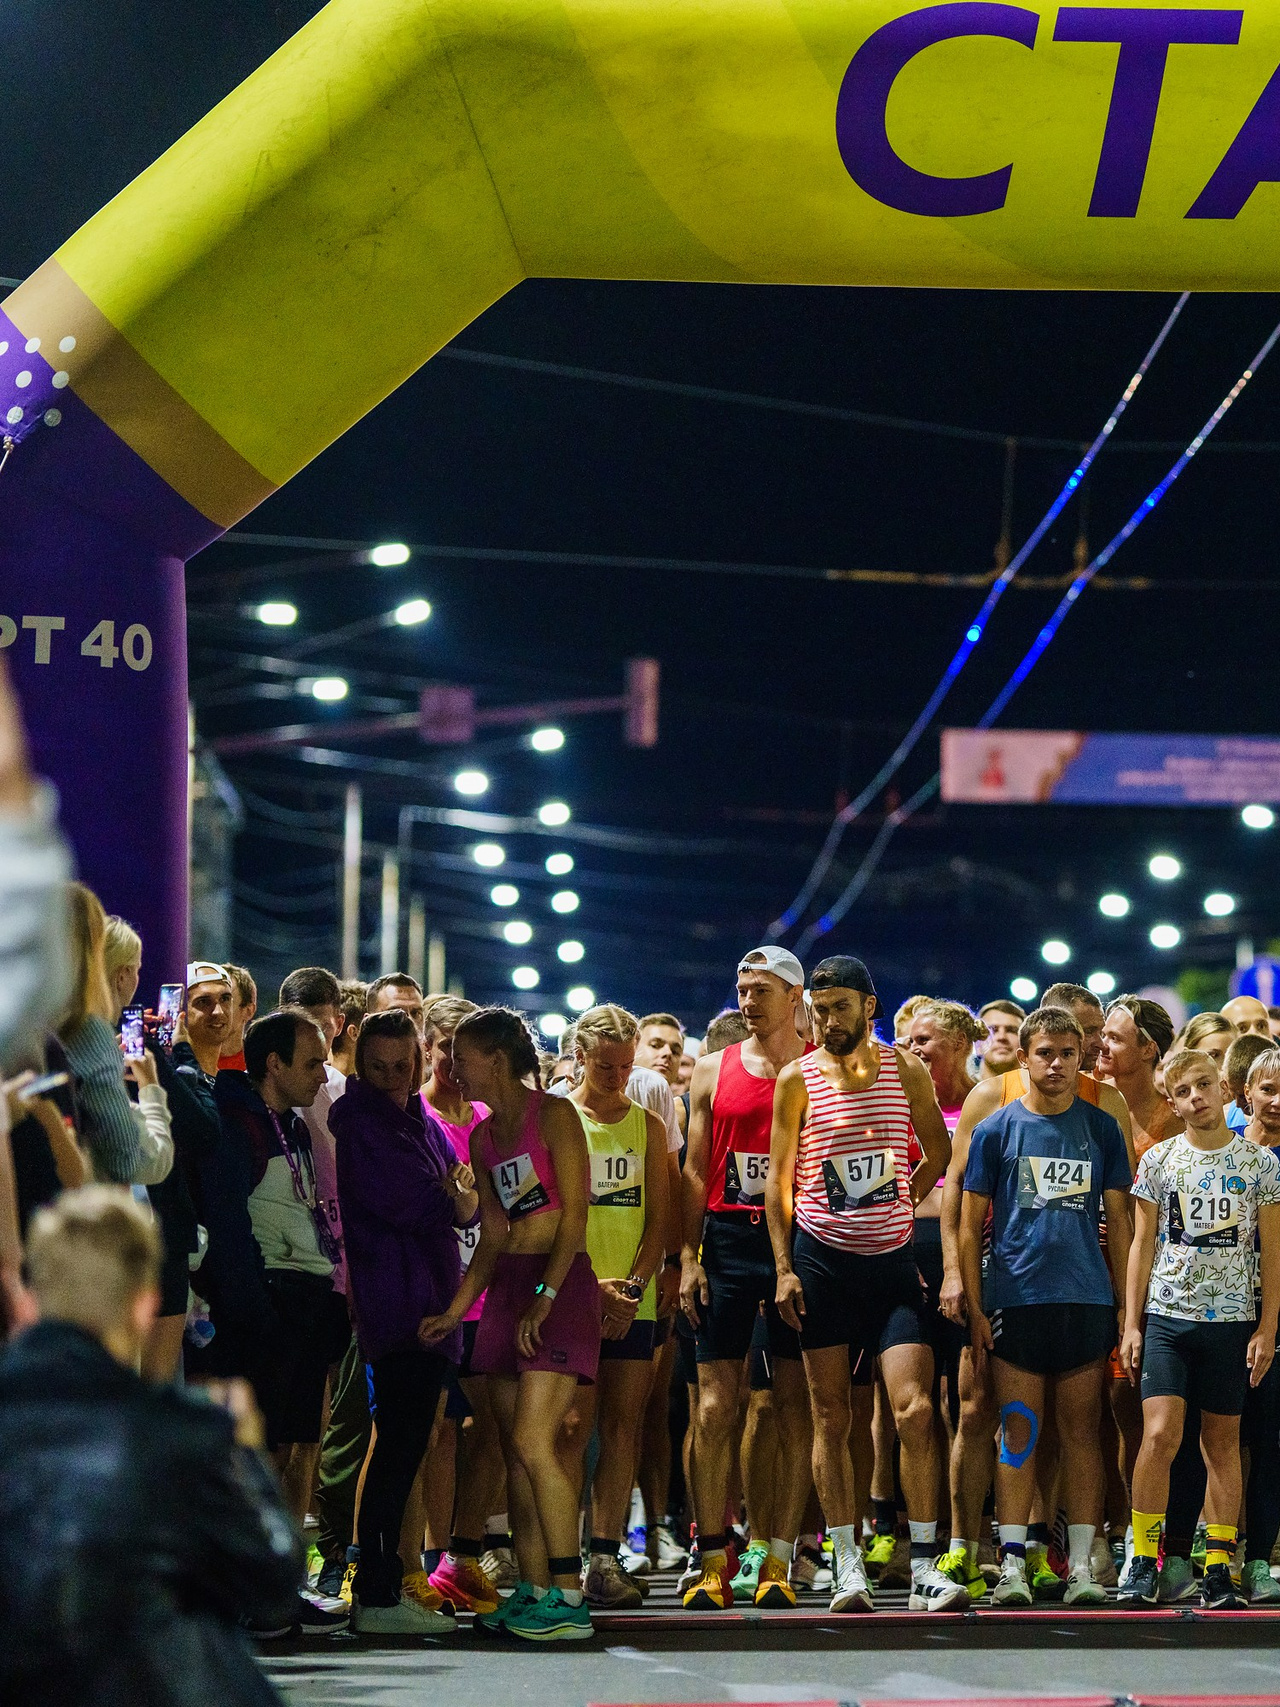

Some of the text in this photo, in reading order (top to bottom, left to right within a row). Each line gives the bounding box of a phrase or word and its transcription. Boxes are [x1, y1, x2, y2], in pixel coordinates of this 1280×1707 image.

[81, 620, 153, 671] 40
[501, 1161, 519, 1189] 47
[605, 1157, 627, 1180] 10
[847, 1152, 885, 1182] 577
[1043, 1161, 1084, 1187] 424
[597, 1181, 620, 1189] ВАЛЕРИЯ
[1047, 1185, 1068, 1193] РУСЛАН
[1190, 1197, 1231, 1221] 219
[1194, 1221, 1215, 1230] МАТВЕЙ
